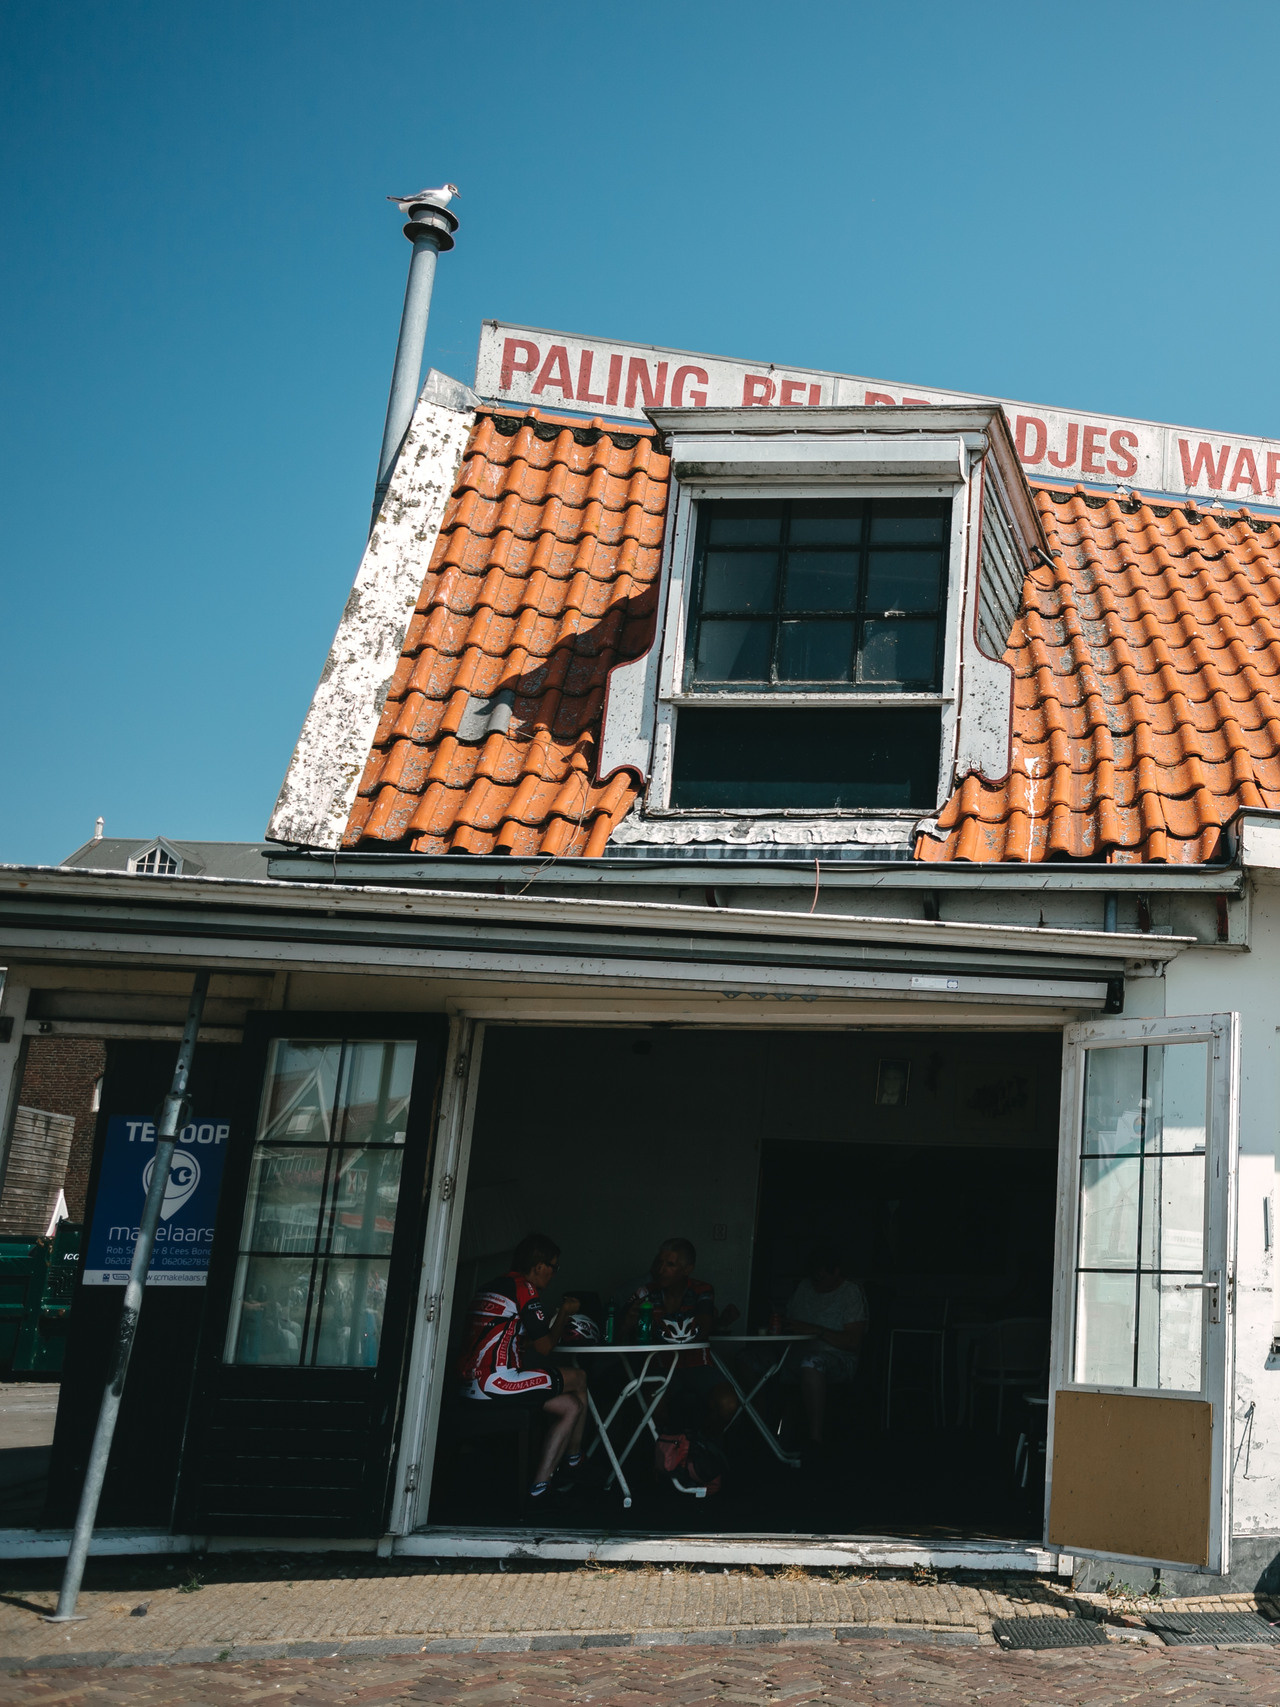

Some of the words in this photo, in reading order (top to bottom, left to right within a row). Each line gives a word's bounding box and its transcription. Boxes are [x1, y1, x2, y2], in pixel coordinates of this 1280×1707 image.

[499, 337, 709, 407] PALING
[1006, 413, 1138, 478] DJES
[126, 1121, 155, 1142] TE
[178, 1124, 230, 1145] OOP
[169, 1166, 192, 1186] c
[108, 1224, 215, 1242] maelaars
[106, 1246, 123, 1254] Rob
[126, 1246, 159, 1255] Scer
[170, 1247, 189, 1255] Cees
[501, 1376, 543, 1391] HUMARD
